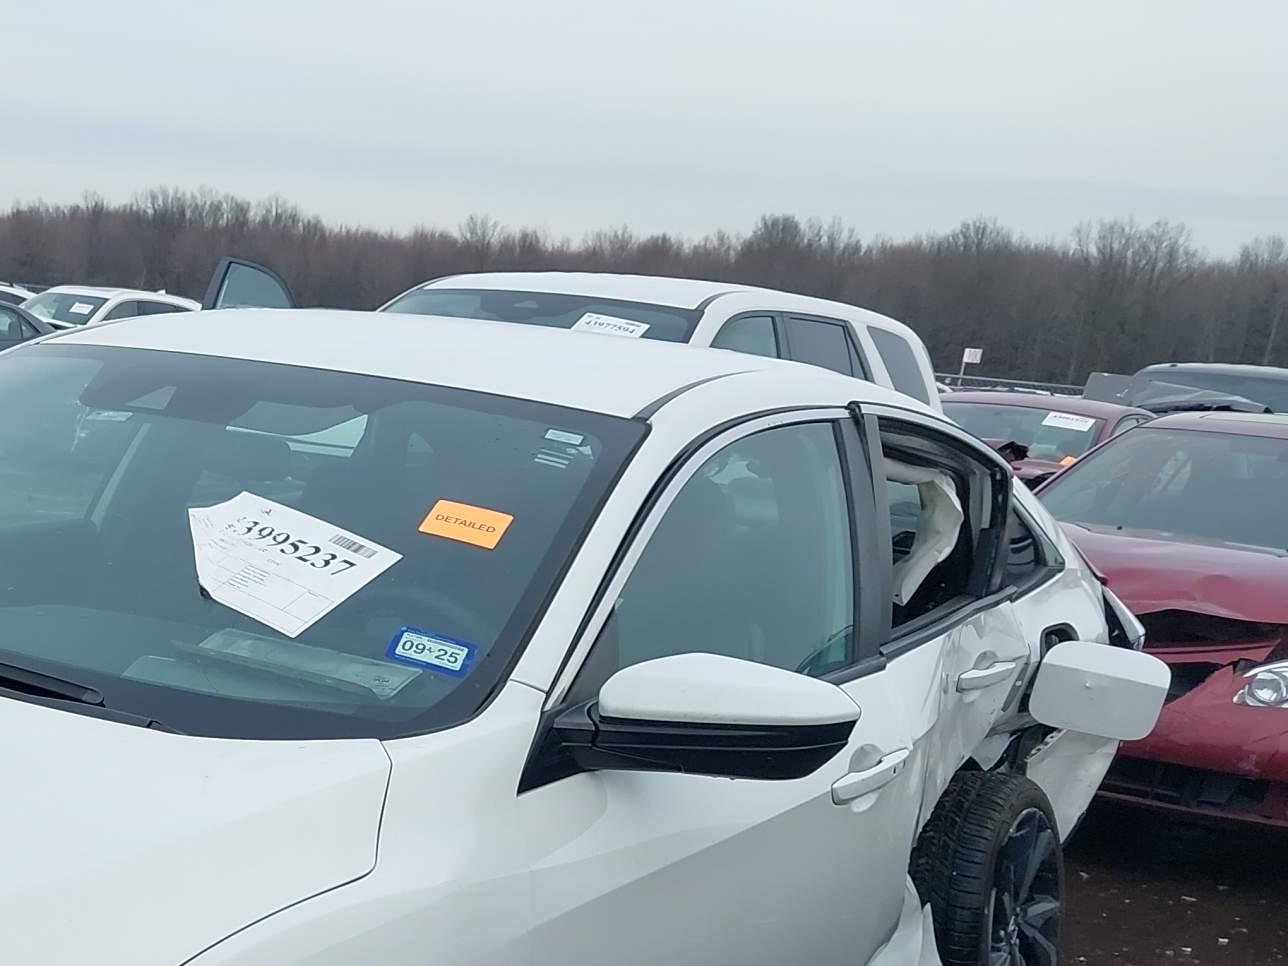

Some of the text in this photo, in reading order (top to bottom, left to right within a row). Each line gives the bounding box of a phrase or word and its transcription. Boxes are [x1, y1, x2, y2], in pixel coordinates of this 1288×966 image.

[435, 514, 496, 533] DETAILED
[401, 639, 427, 655] 09
[434, 648, 460, 664] 25
